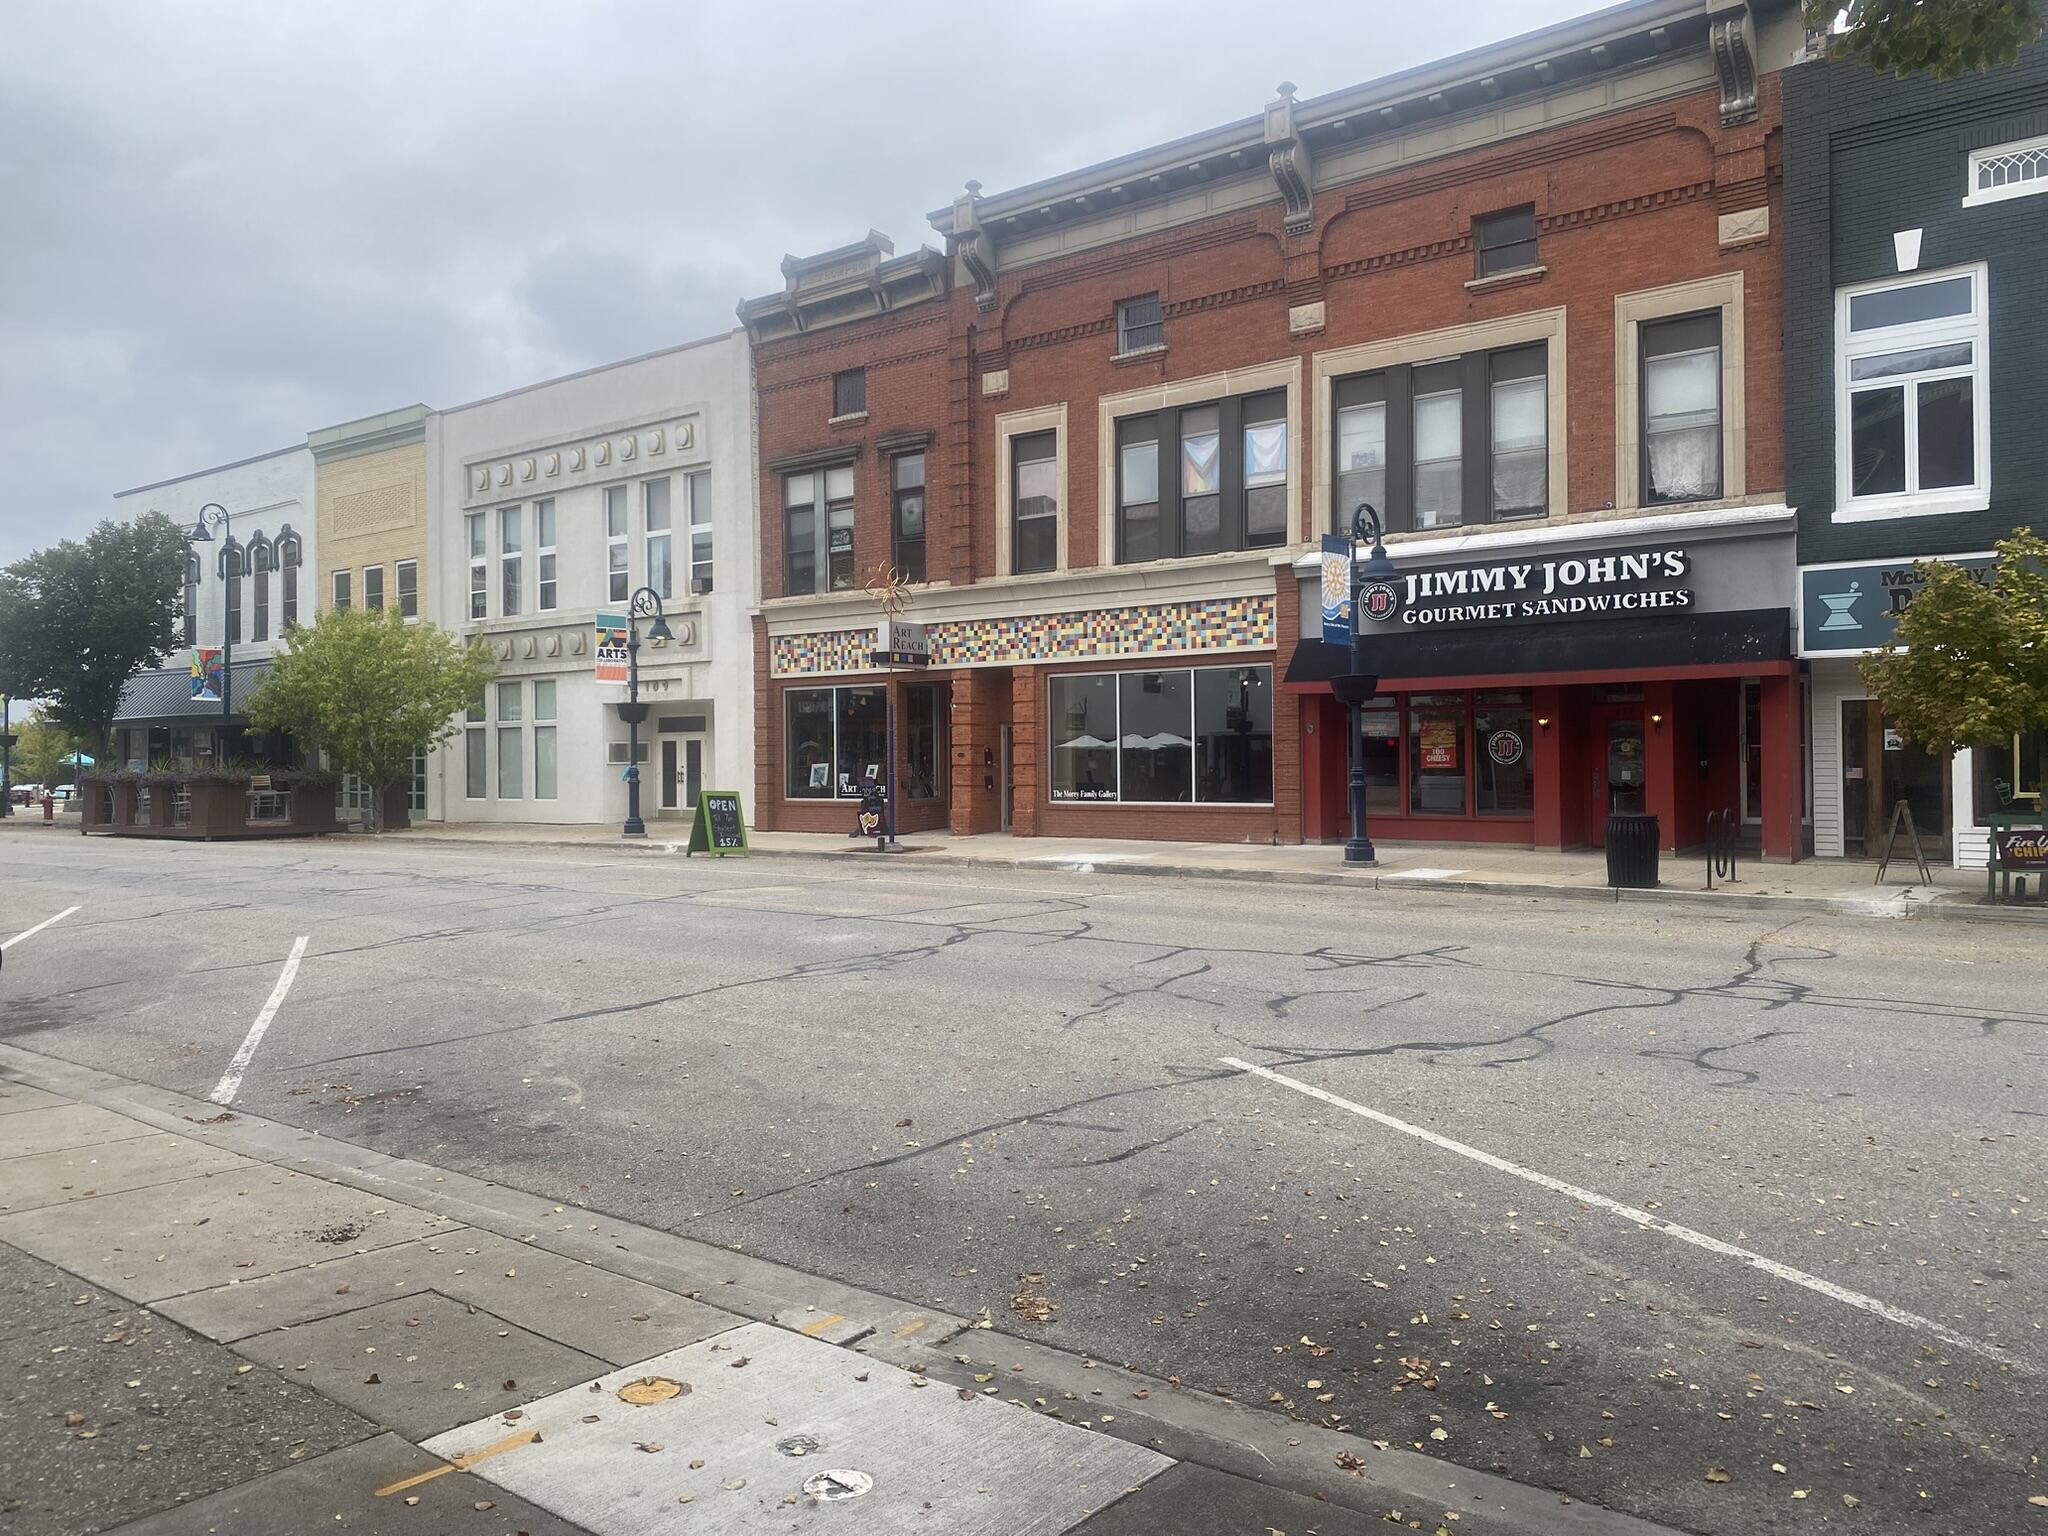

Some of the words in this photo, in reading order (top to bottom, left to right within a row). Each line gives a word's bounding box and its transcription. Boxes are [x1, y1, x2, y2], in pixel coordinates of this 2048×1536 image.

[1405, 565, 1531, 605] JIMMY
[1542, 550, 1686, 595] JOHN'S
[1364, 585, 1378, 603] JIMMY
[1371, 593, 1387, 611] JJ
[1402, 603, 1516, 625] GOURMET
[1522, 589, 1689, 617] SANDWICHES
[893, 625, 912, 638] ART
[893, 637, 924, 651] REACH
[597, 648, 627, 659] ARTS
[1498, 739, 1513, 756] JJ
[1426, 754, 1451, 762] CHEESY
[841, 783, 857, 793] ART
[1053, 790, 1063, 798] The
[1080, 790, 1097, 799] Family
[1098, 790, 1117, 800] Gallery
[709, 799, 736, 811] OPEN
[719, 838, 738, 847] 15%
[2005, 835, 2035, 848] Fire
[2036, 835, 2048, 848] U
[2013, 846, 2048, 857] CHIP
